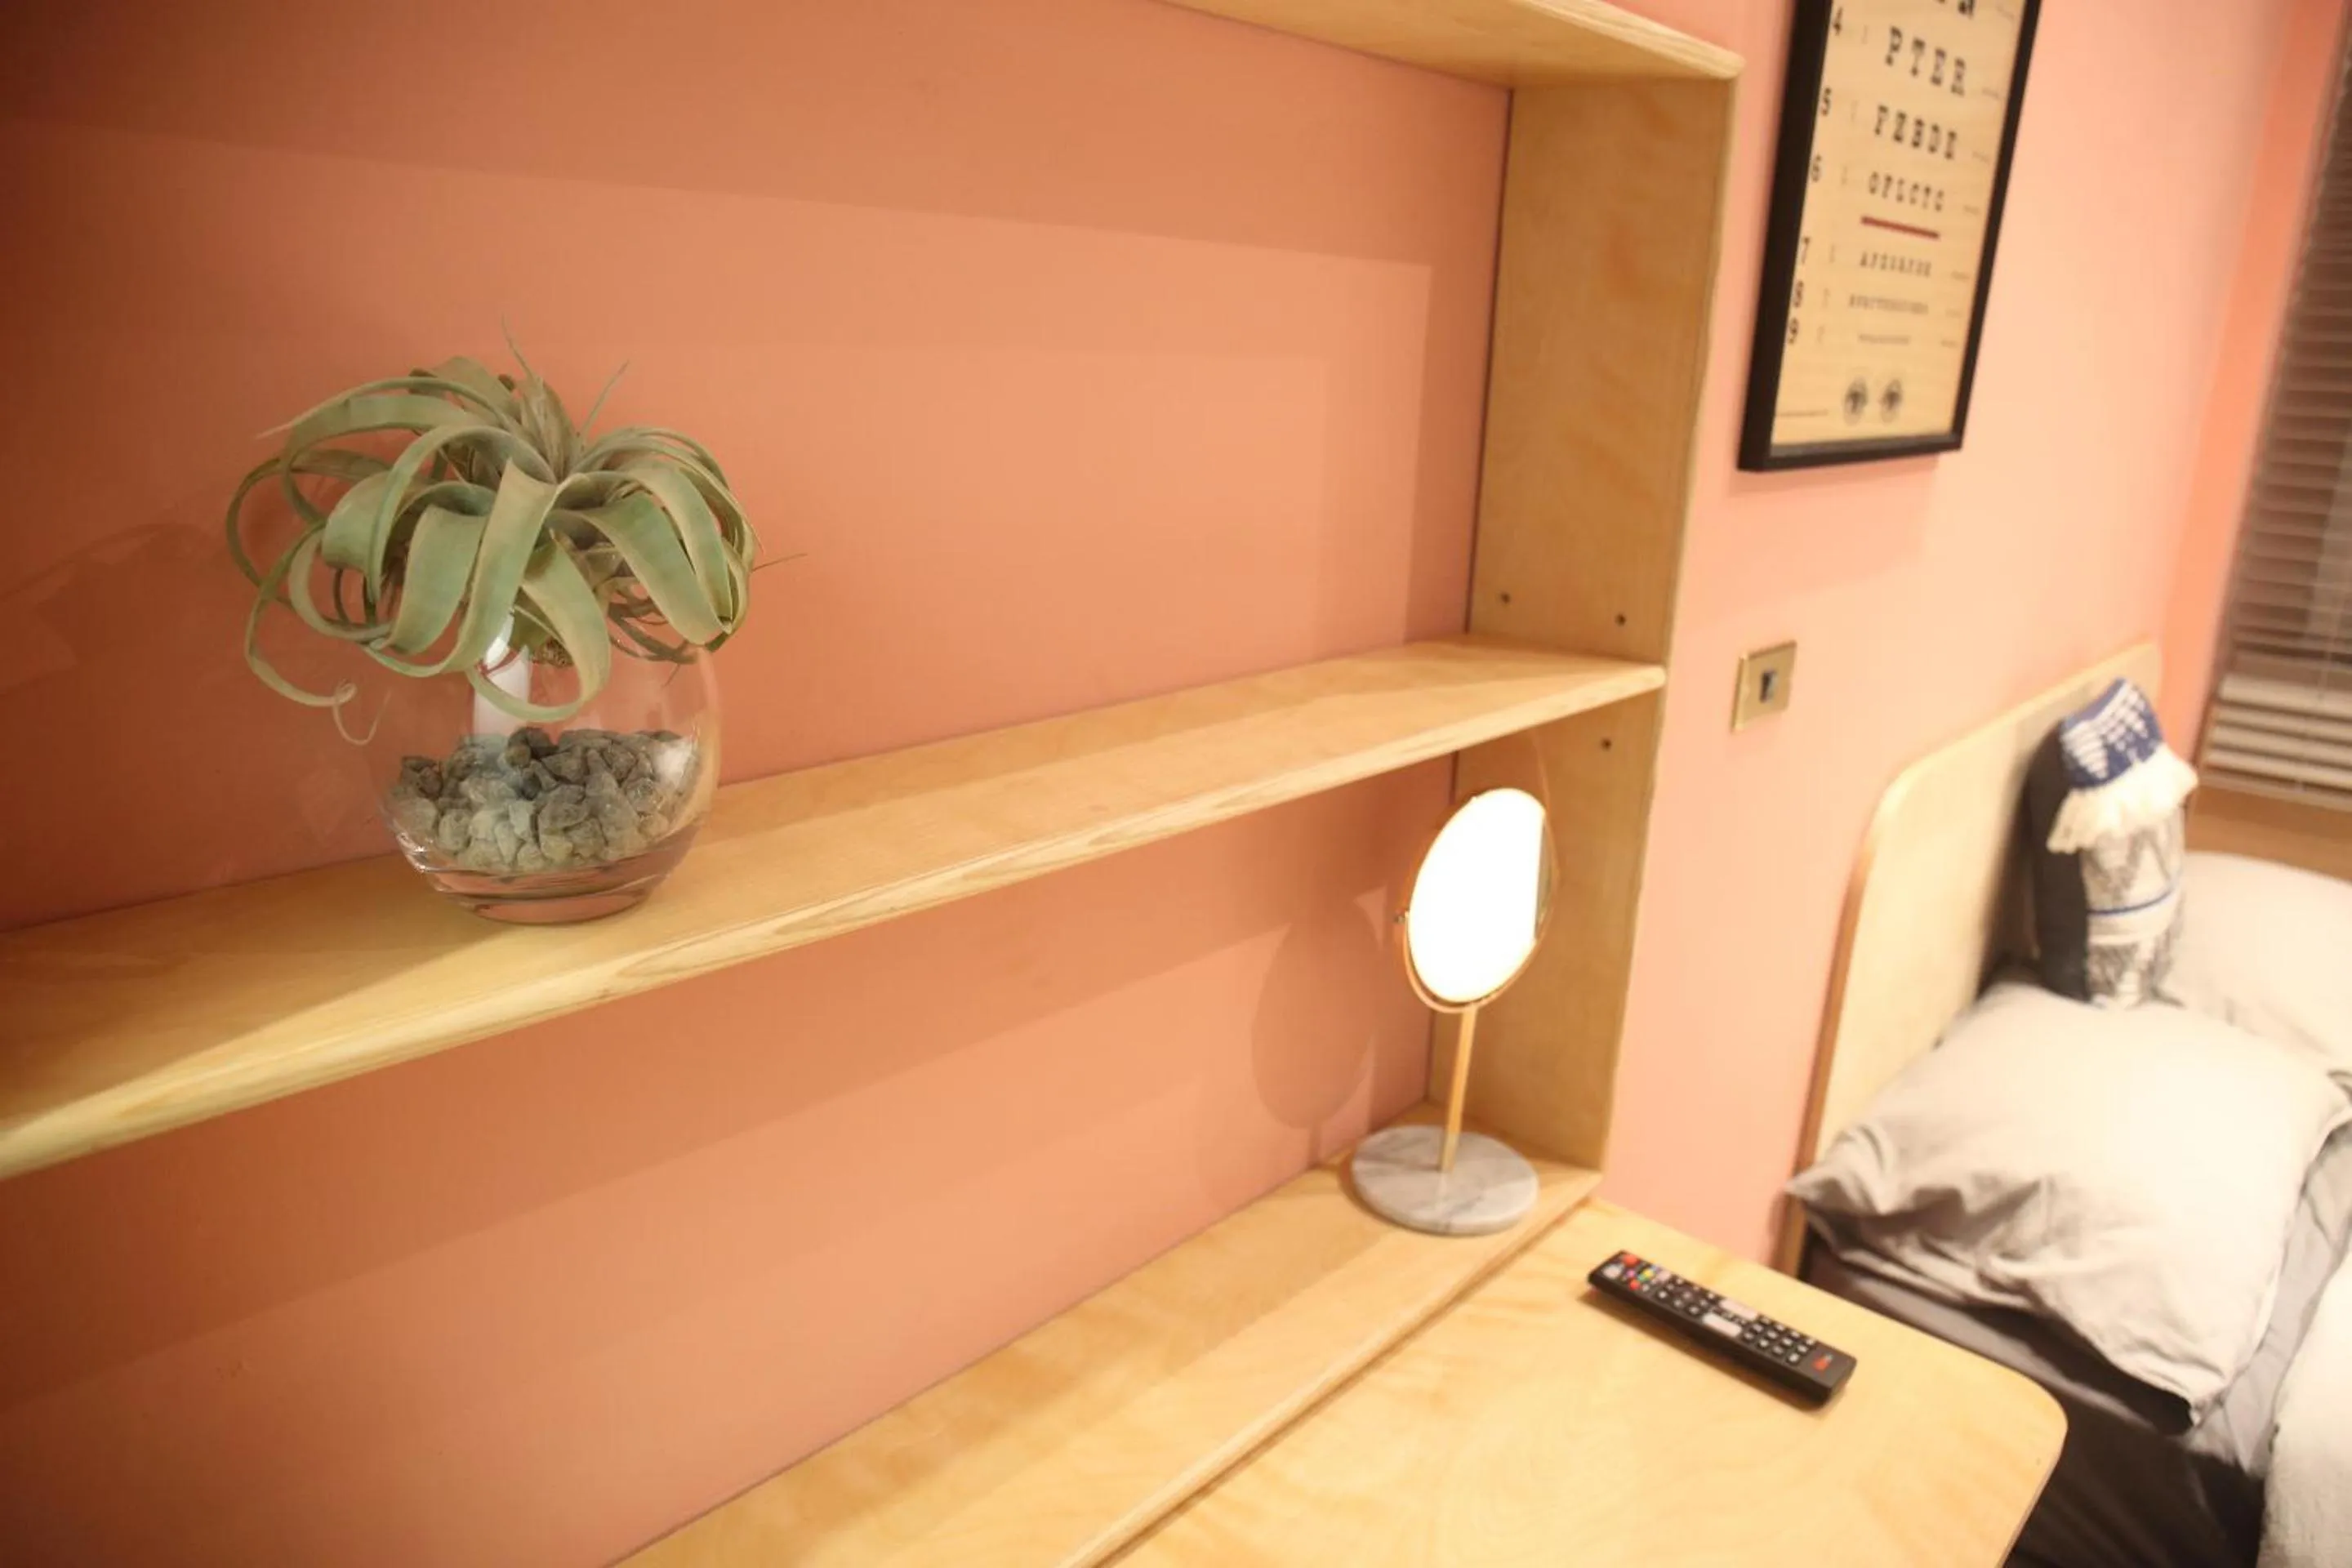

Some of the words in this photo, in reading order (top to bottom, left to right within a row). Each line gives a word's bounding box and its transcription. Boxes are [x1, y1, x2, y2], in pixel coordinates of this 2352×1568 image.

[1885, 25, 1966, 96] PTER
[1820, 87, 1832, 116] 5
[1811, 154, 1822, 182] 6
[1800, 236, 1810, 265] 7
[1793, 279, 1804, 308] 8
[1788, 317, 1799, 345] 9
